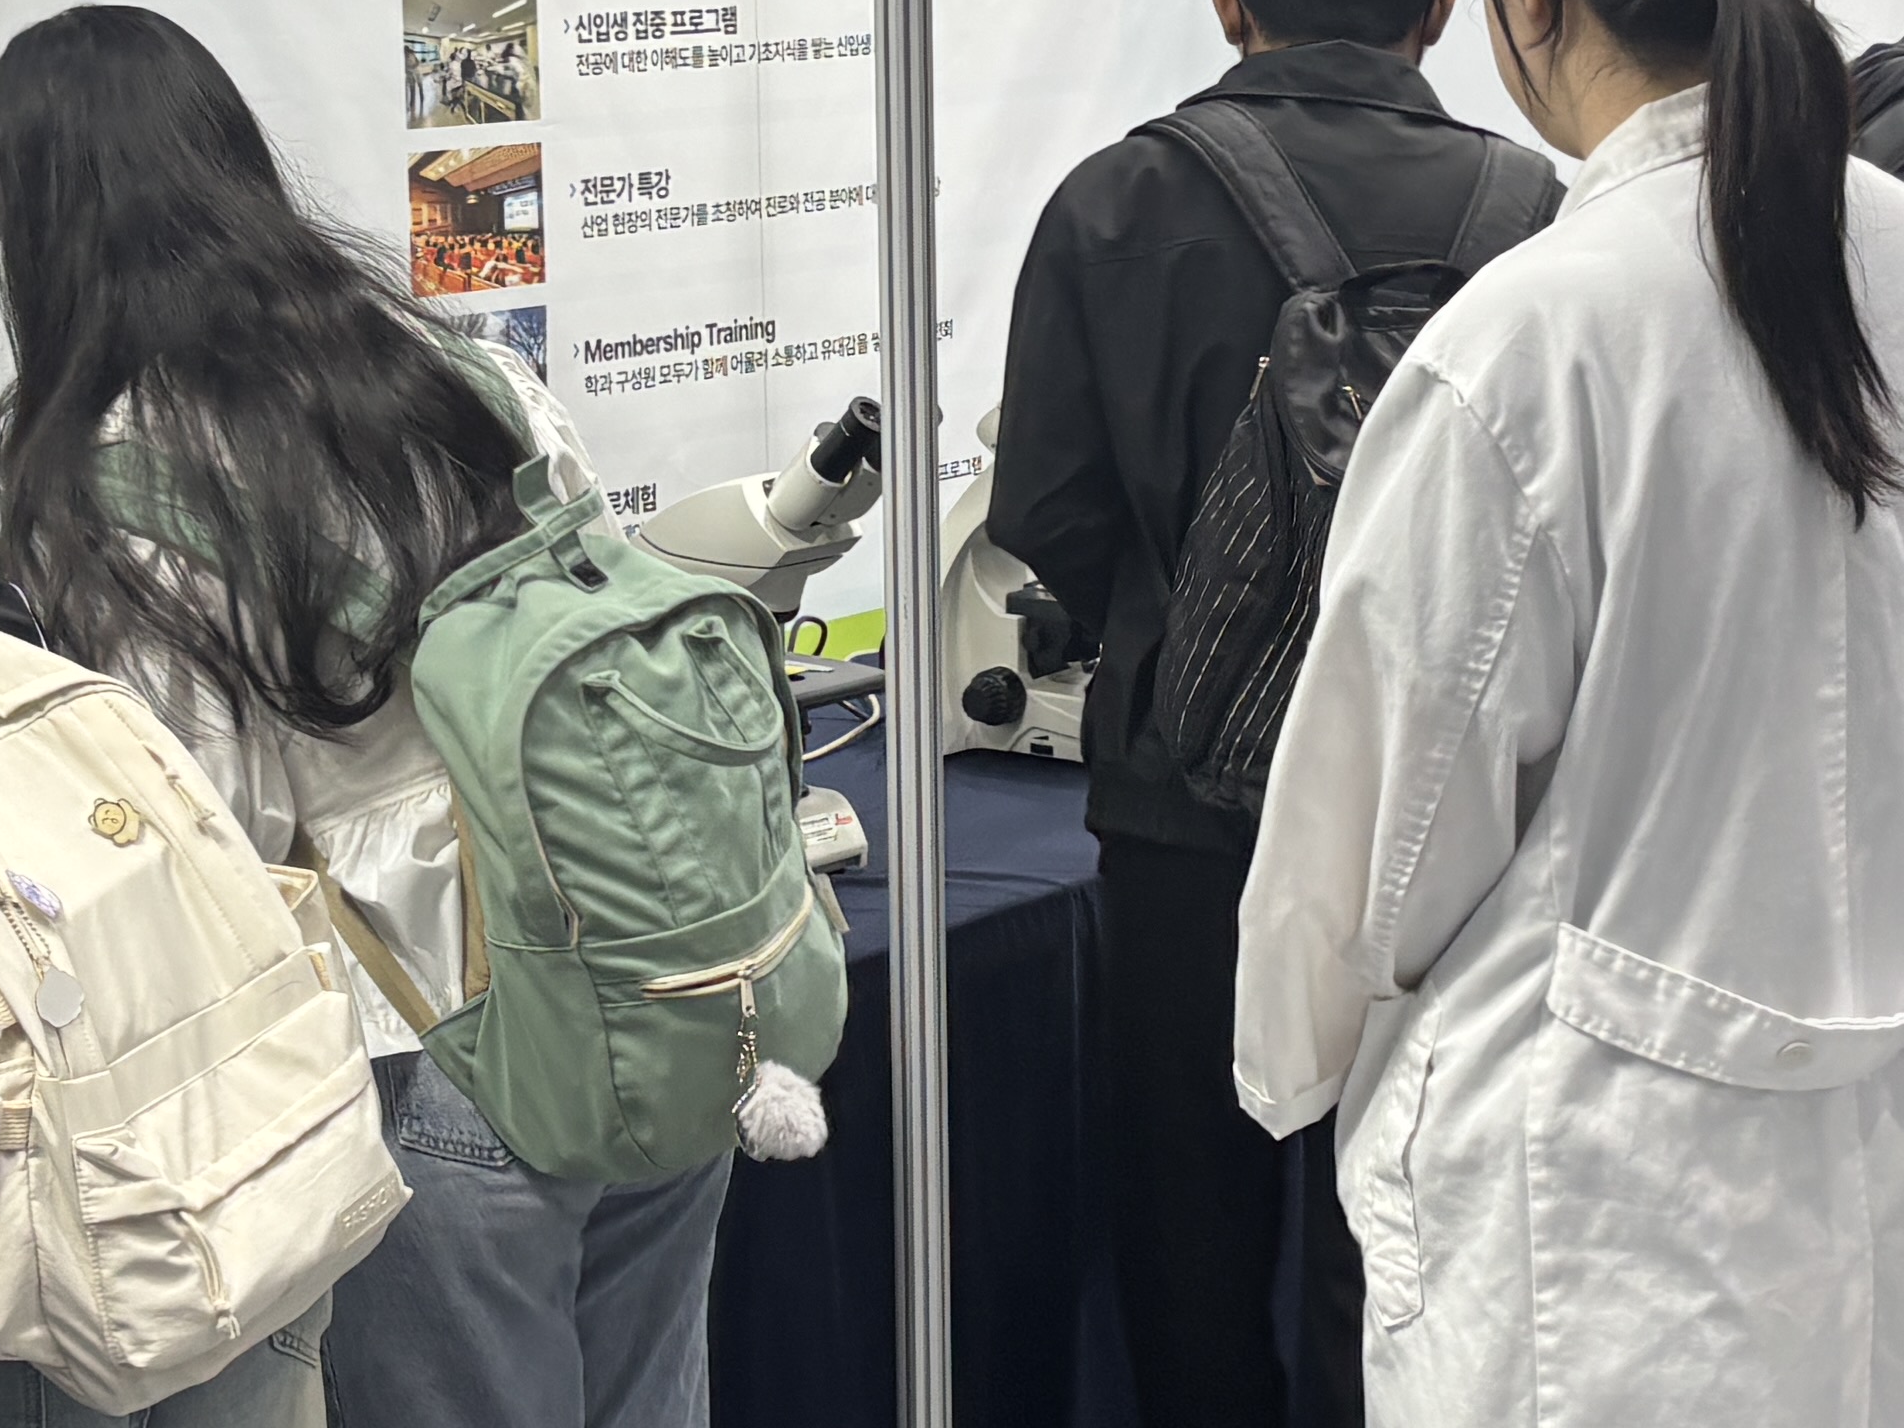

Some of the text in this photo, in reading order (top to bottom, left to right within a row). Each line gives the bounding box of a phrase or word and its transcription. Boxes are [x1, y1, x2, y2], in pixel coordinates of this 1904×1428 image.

[575, 6, 737, 43] 신입생 집중 프로그램
[621, 49, 648, 73] 대한
[581, 169, 671, 206] 전문가 특강
[585, 316, 775, 368] Membership Training
